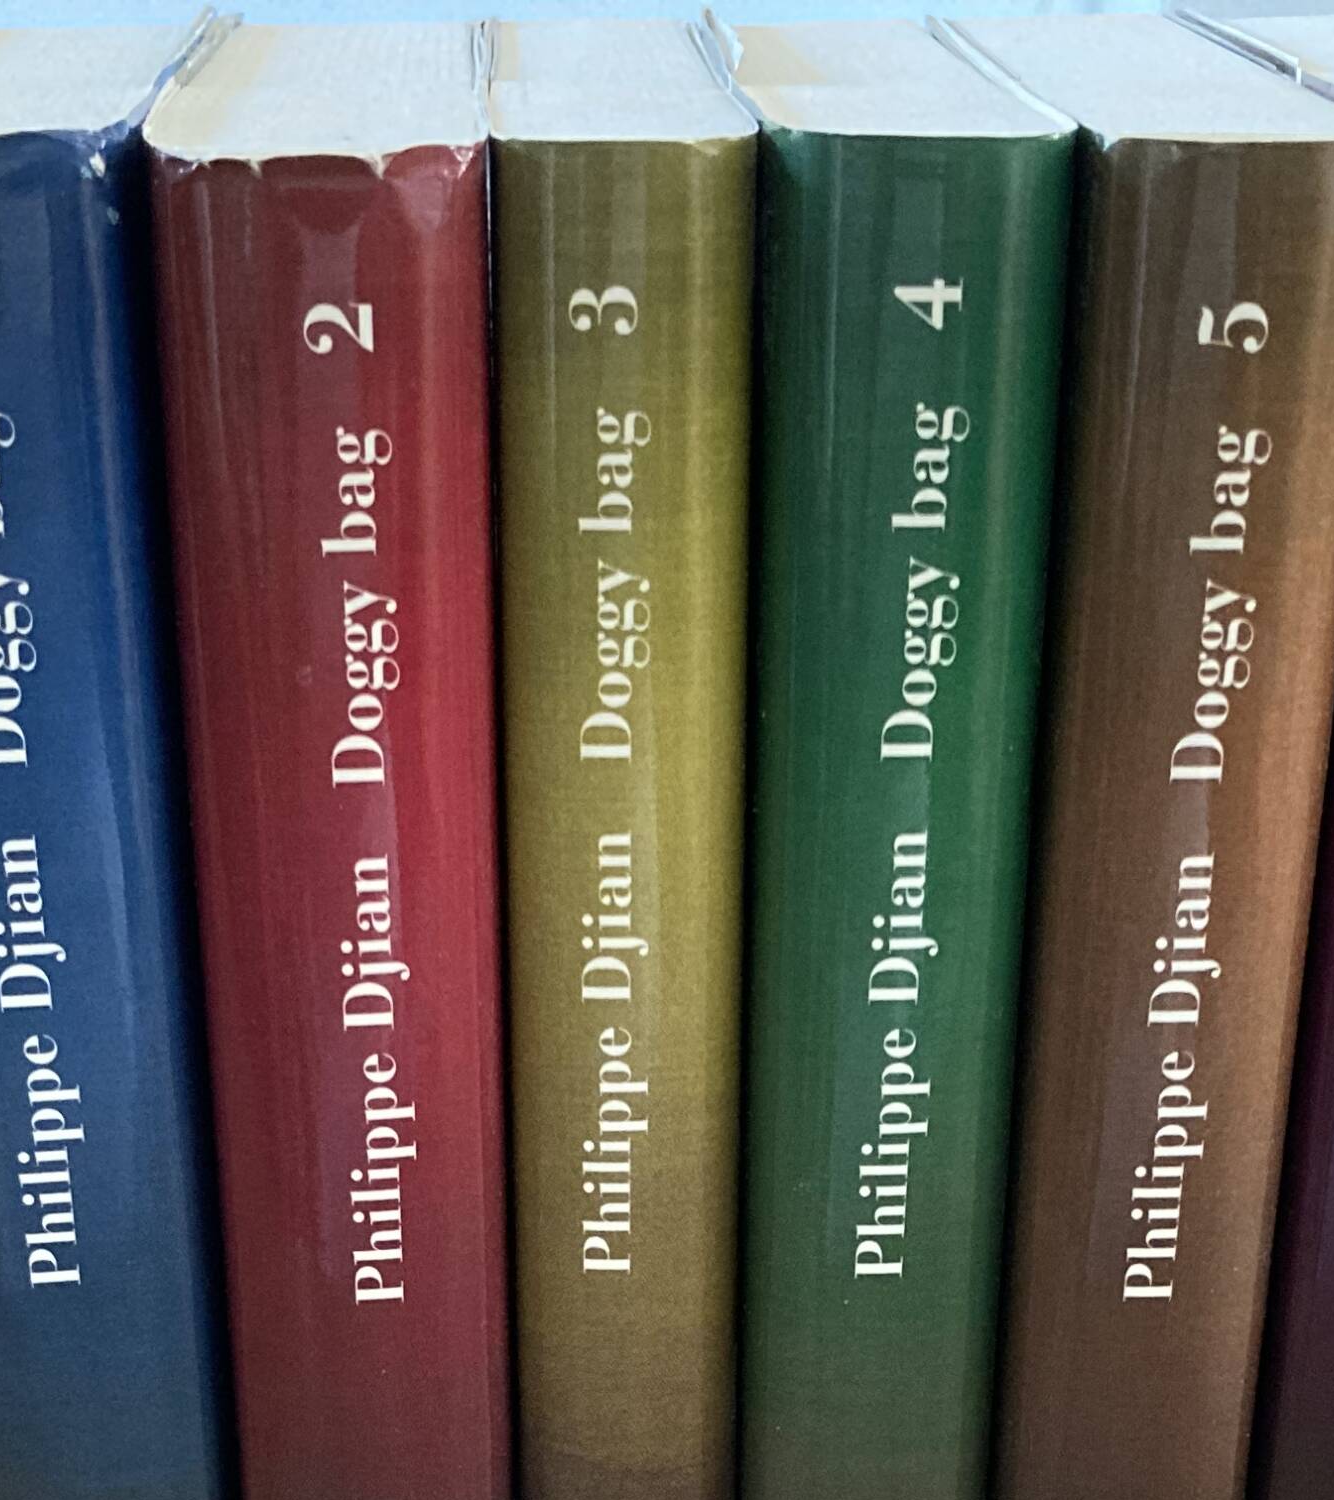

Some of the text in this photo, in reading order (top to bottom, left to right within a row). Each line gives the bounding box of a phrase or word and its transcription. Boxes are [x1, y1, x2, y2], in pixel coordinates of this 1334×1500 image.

[17, 1035, 85, 1286] Philippe
[303, 303, 417, 1304] Philippe Djian Doggy bag 2
[569, 285, 651, 1271] Philippe Djian Doggy bag 3
[854, 278, 969, 1278] Philippe Djian Doggy bag 4
[1123, 302, 1270, 1298] Philippe Djian Doggy bag 5
